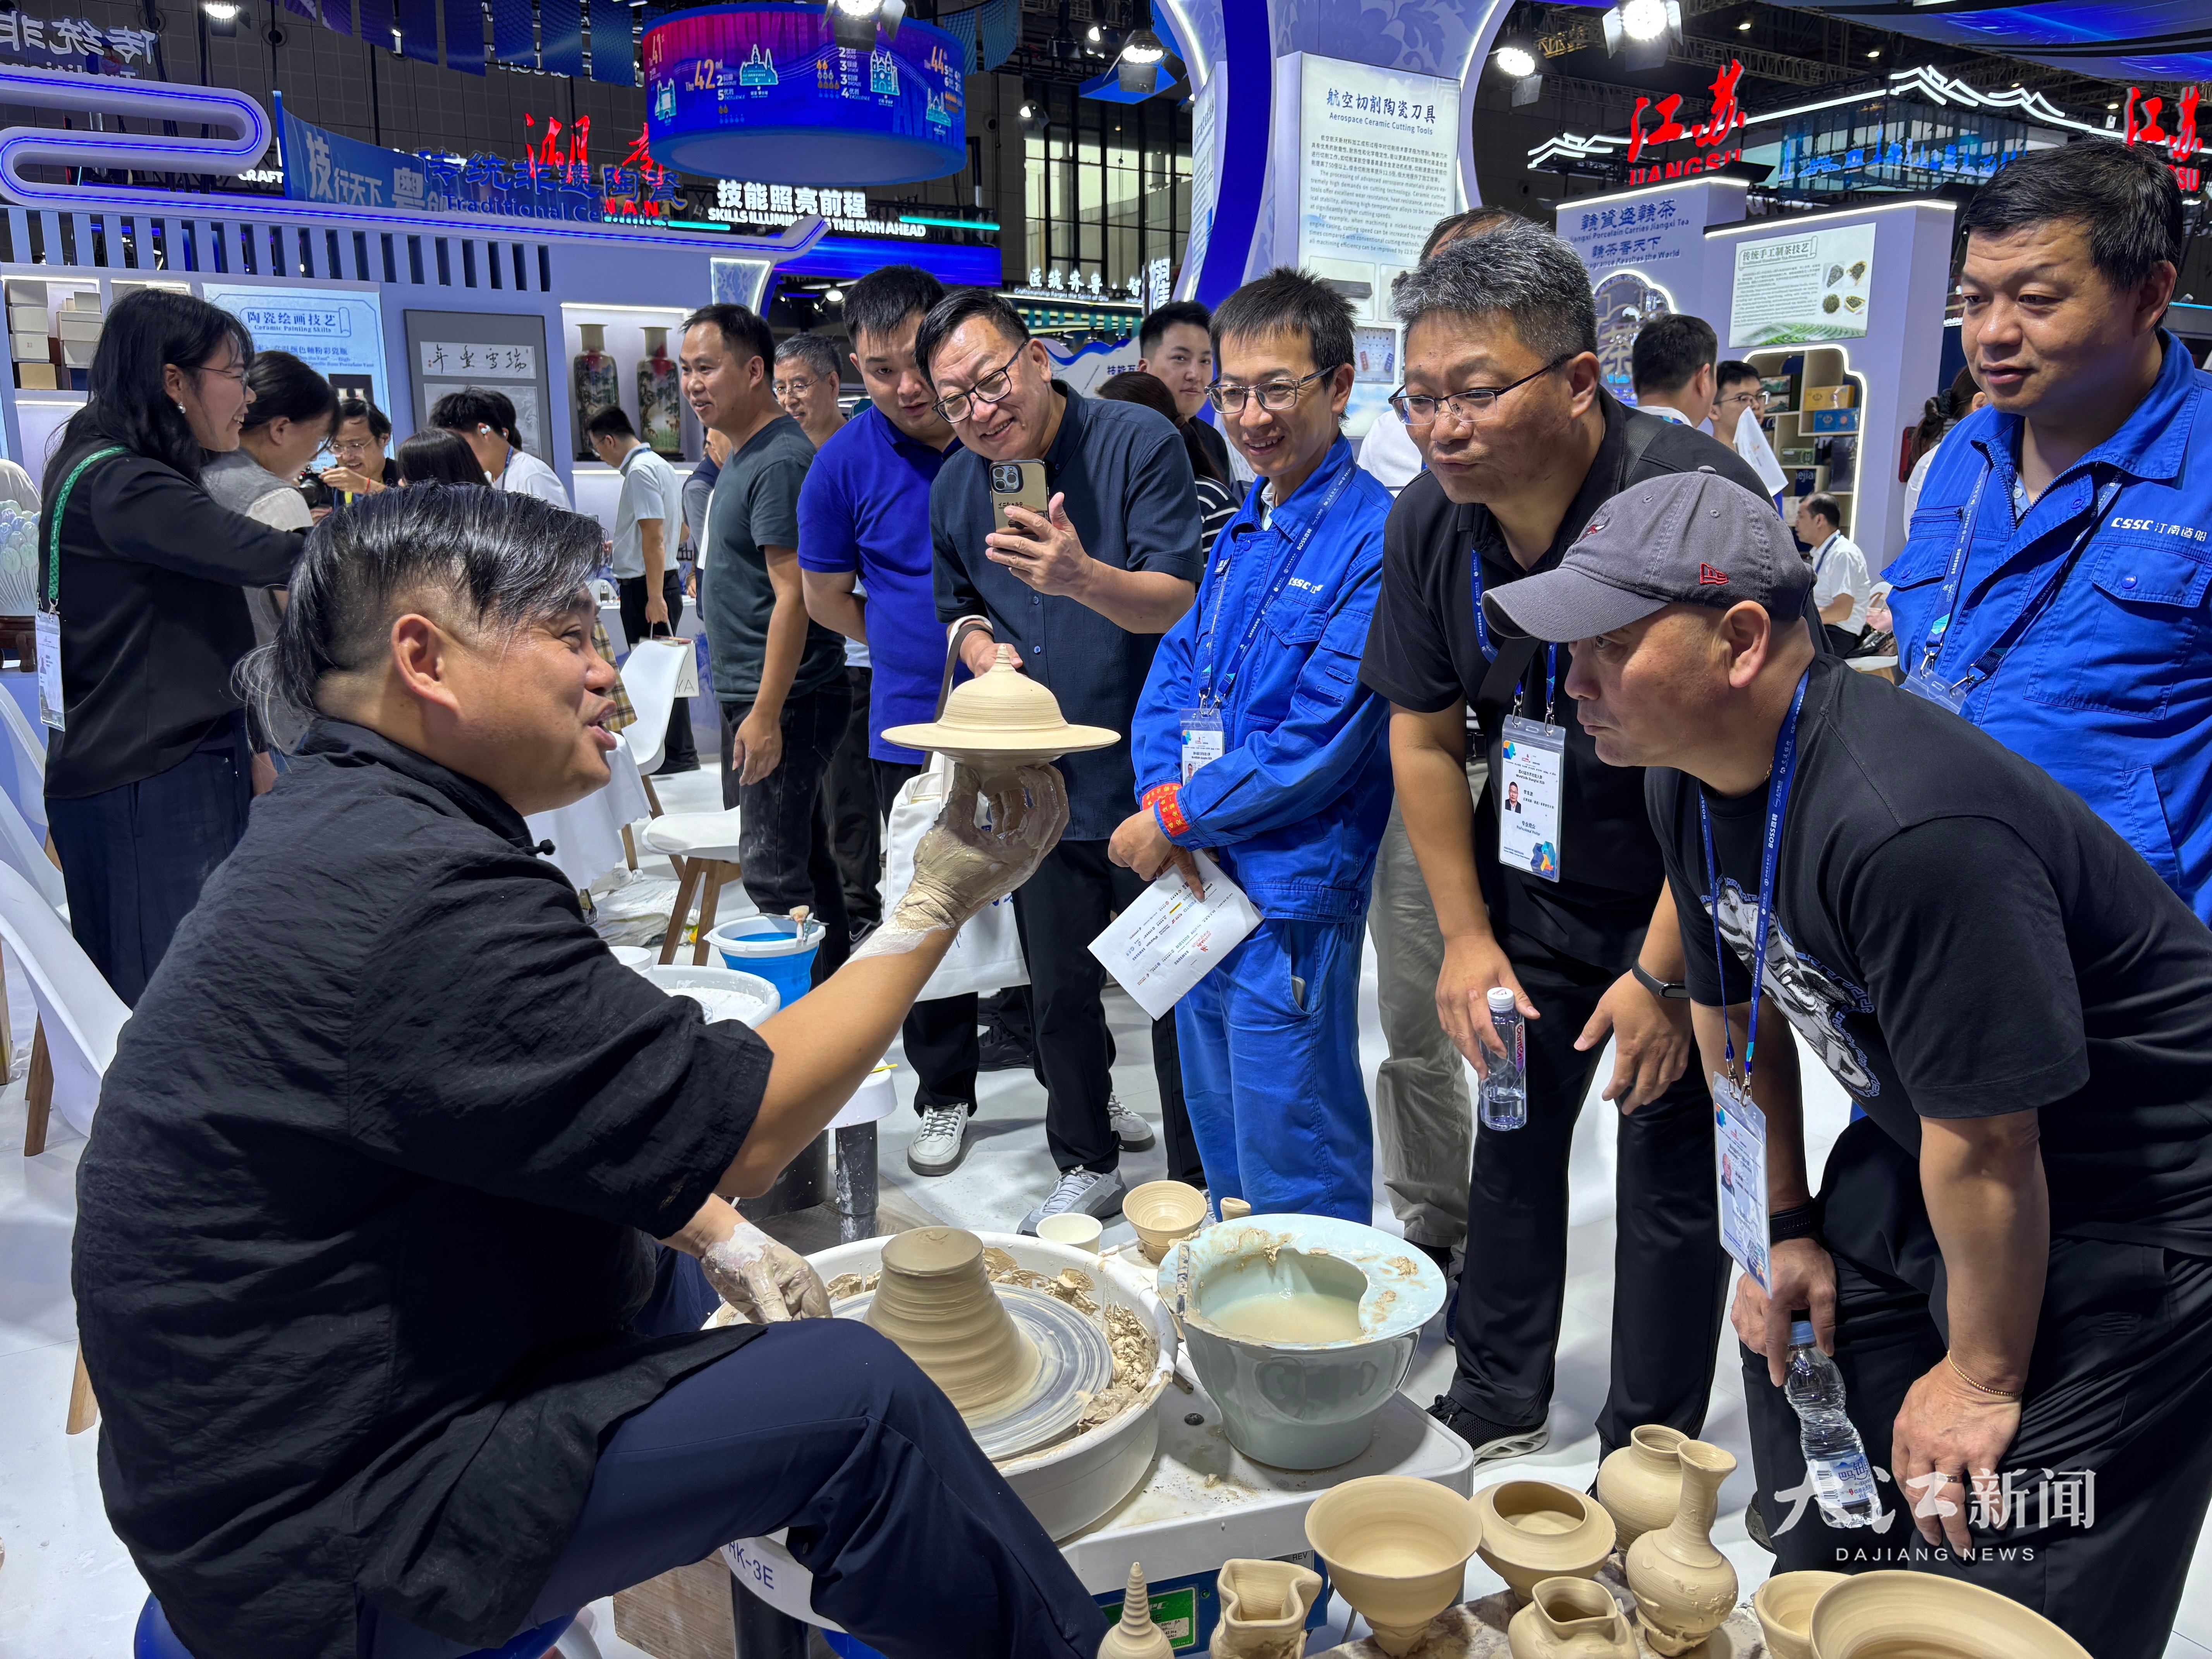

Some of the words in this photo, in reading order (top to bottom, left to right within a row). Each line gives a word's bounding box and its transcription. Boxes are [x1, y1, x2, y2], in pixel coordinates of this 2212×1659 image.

[840, 60, 847, 71] 3
[840, 74, 847, 85] 3
[841, 87, 849, 98] 4
[1327, 88, 1436, 124] 航空切削陶瓷刀具
[1628, 58, 1745, 162] 江苏
[1329, 112, 1363, 124] Aerospace
[1365, 118, 1390, 128] Ceramic
[1392, 122, 1415, 134] Cutting
[1417, 126, 1433, 135] Tools
[2125, 86, 2203, 162] 江苏
[416, 149, 689, 211] 传统非遗陶瓷
[443, 193, 565, 221] Traditional
[605, 198, 659, 216] NAN
[716, 179, 867, 218] 技能照亮前程
[708, 207, 748, 223] SKILLS
[832, 218, 854, 232] THE
[856, 220, 885, 234] PATH
[885, 223, 926, 237] AHEAD
[1592, 228, 1623, 240] Porcelain
[1625, 225, 1649, 235] Carries
[1650, 220, 1676, 232] Jiangxi
[1678, 218, 1689, 226] Tea
[1592, 236, 1661, 259] 赣茶香天下
[1645, 253, 1657, 262] the
[1658, 249, 1680, 259] World
[1743, 242, 1810, 261] 传统手工制茶技艺
[248, 312, 336, 326] 陶瓷绘画技艺
[2111, 517, 2154, 531] CSSC
[2154, 521, 2208, 542] 江南造船
[1951, 548, 1962, 575] SAMSUNG
[1768, 813, 1778, 849] BOSS直聘
